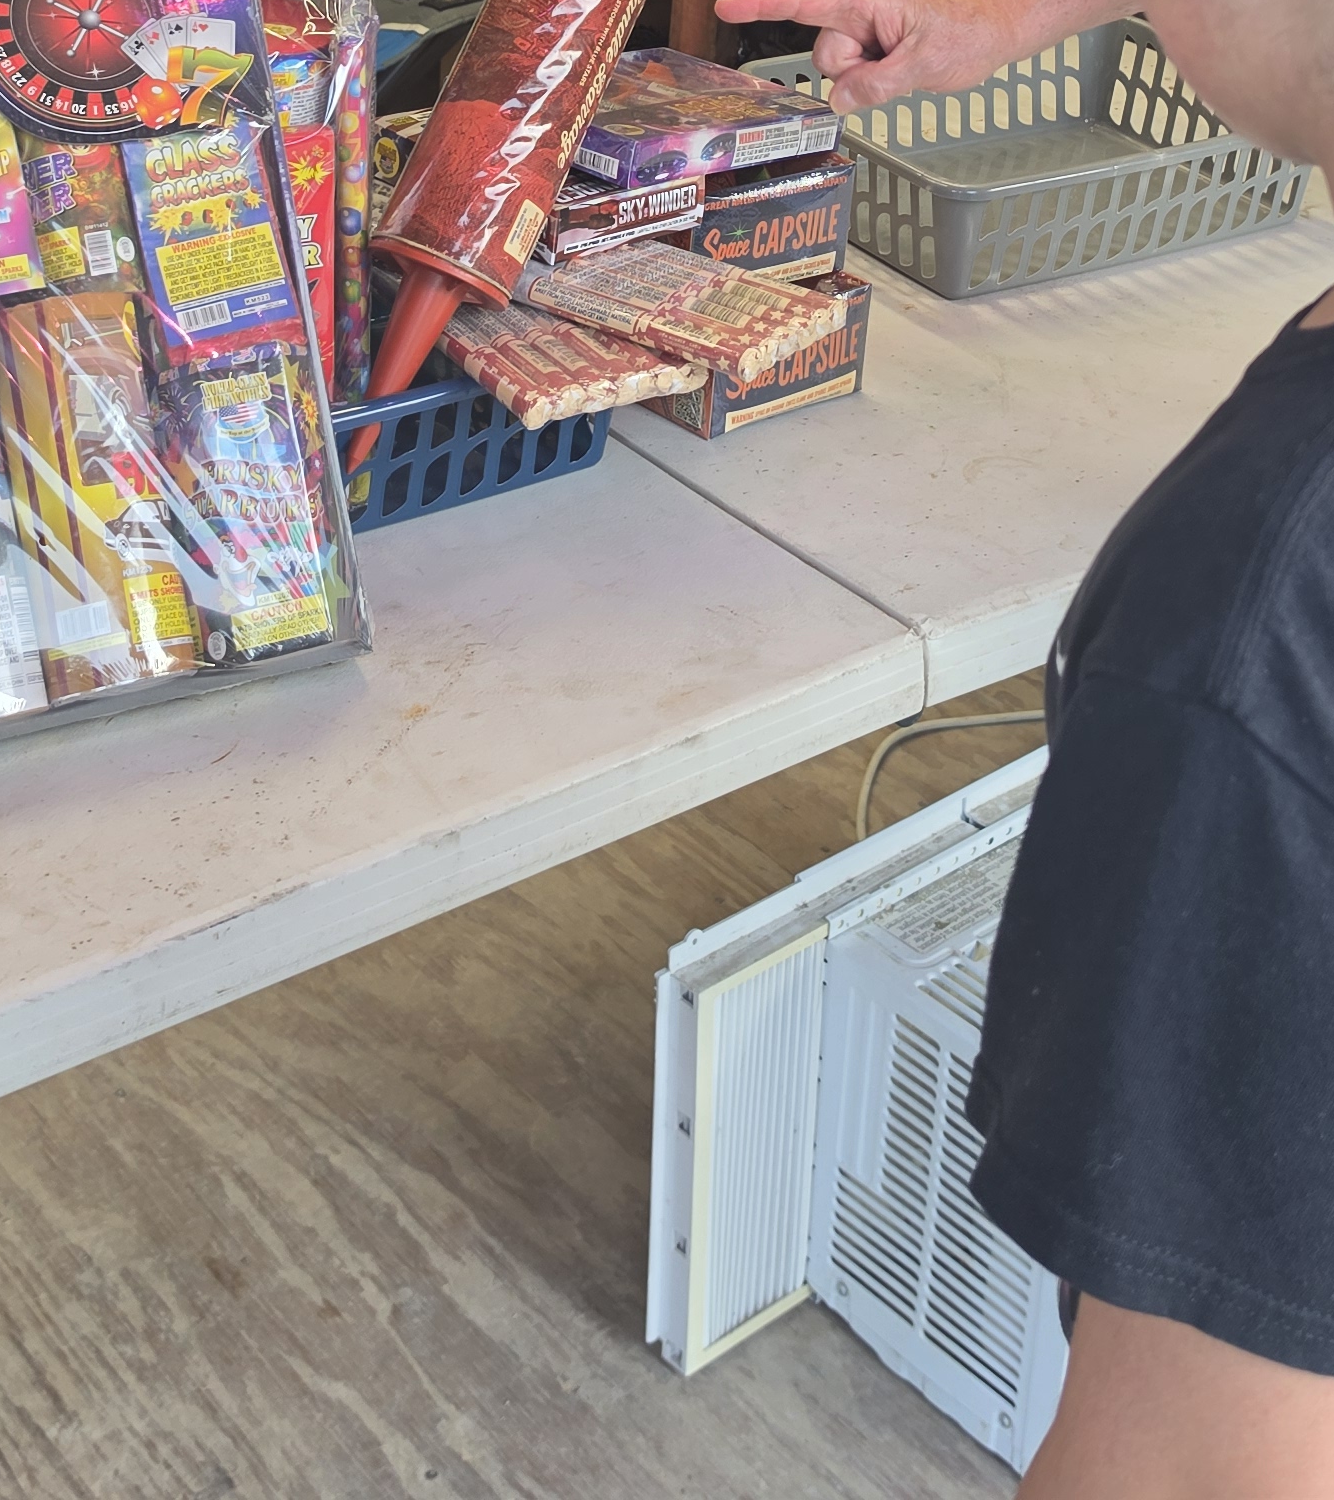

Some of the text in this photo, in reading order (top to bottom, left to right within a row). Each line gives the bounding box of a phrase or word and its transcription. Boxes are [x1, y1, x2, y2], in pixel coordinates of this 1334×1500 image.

[167, 46, 254, 126] 7
[556, 66, 611, 170] Barrage
[145, 133, 241, 183] CLASS
[149, 169, 250, 209] CRACKERS
[172, 236, 216, 253] WARNING
[753, 203, 841, 258] CAPSULE
[2, 266, 23, 277] SPARKS
[201, 458, 305, 492] FRISKY
